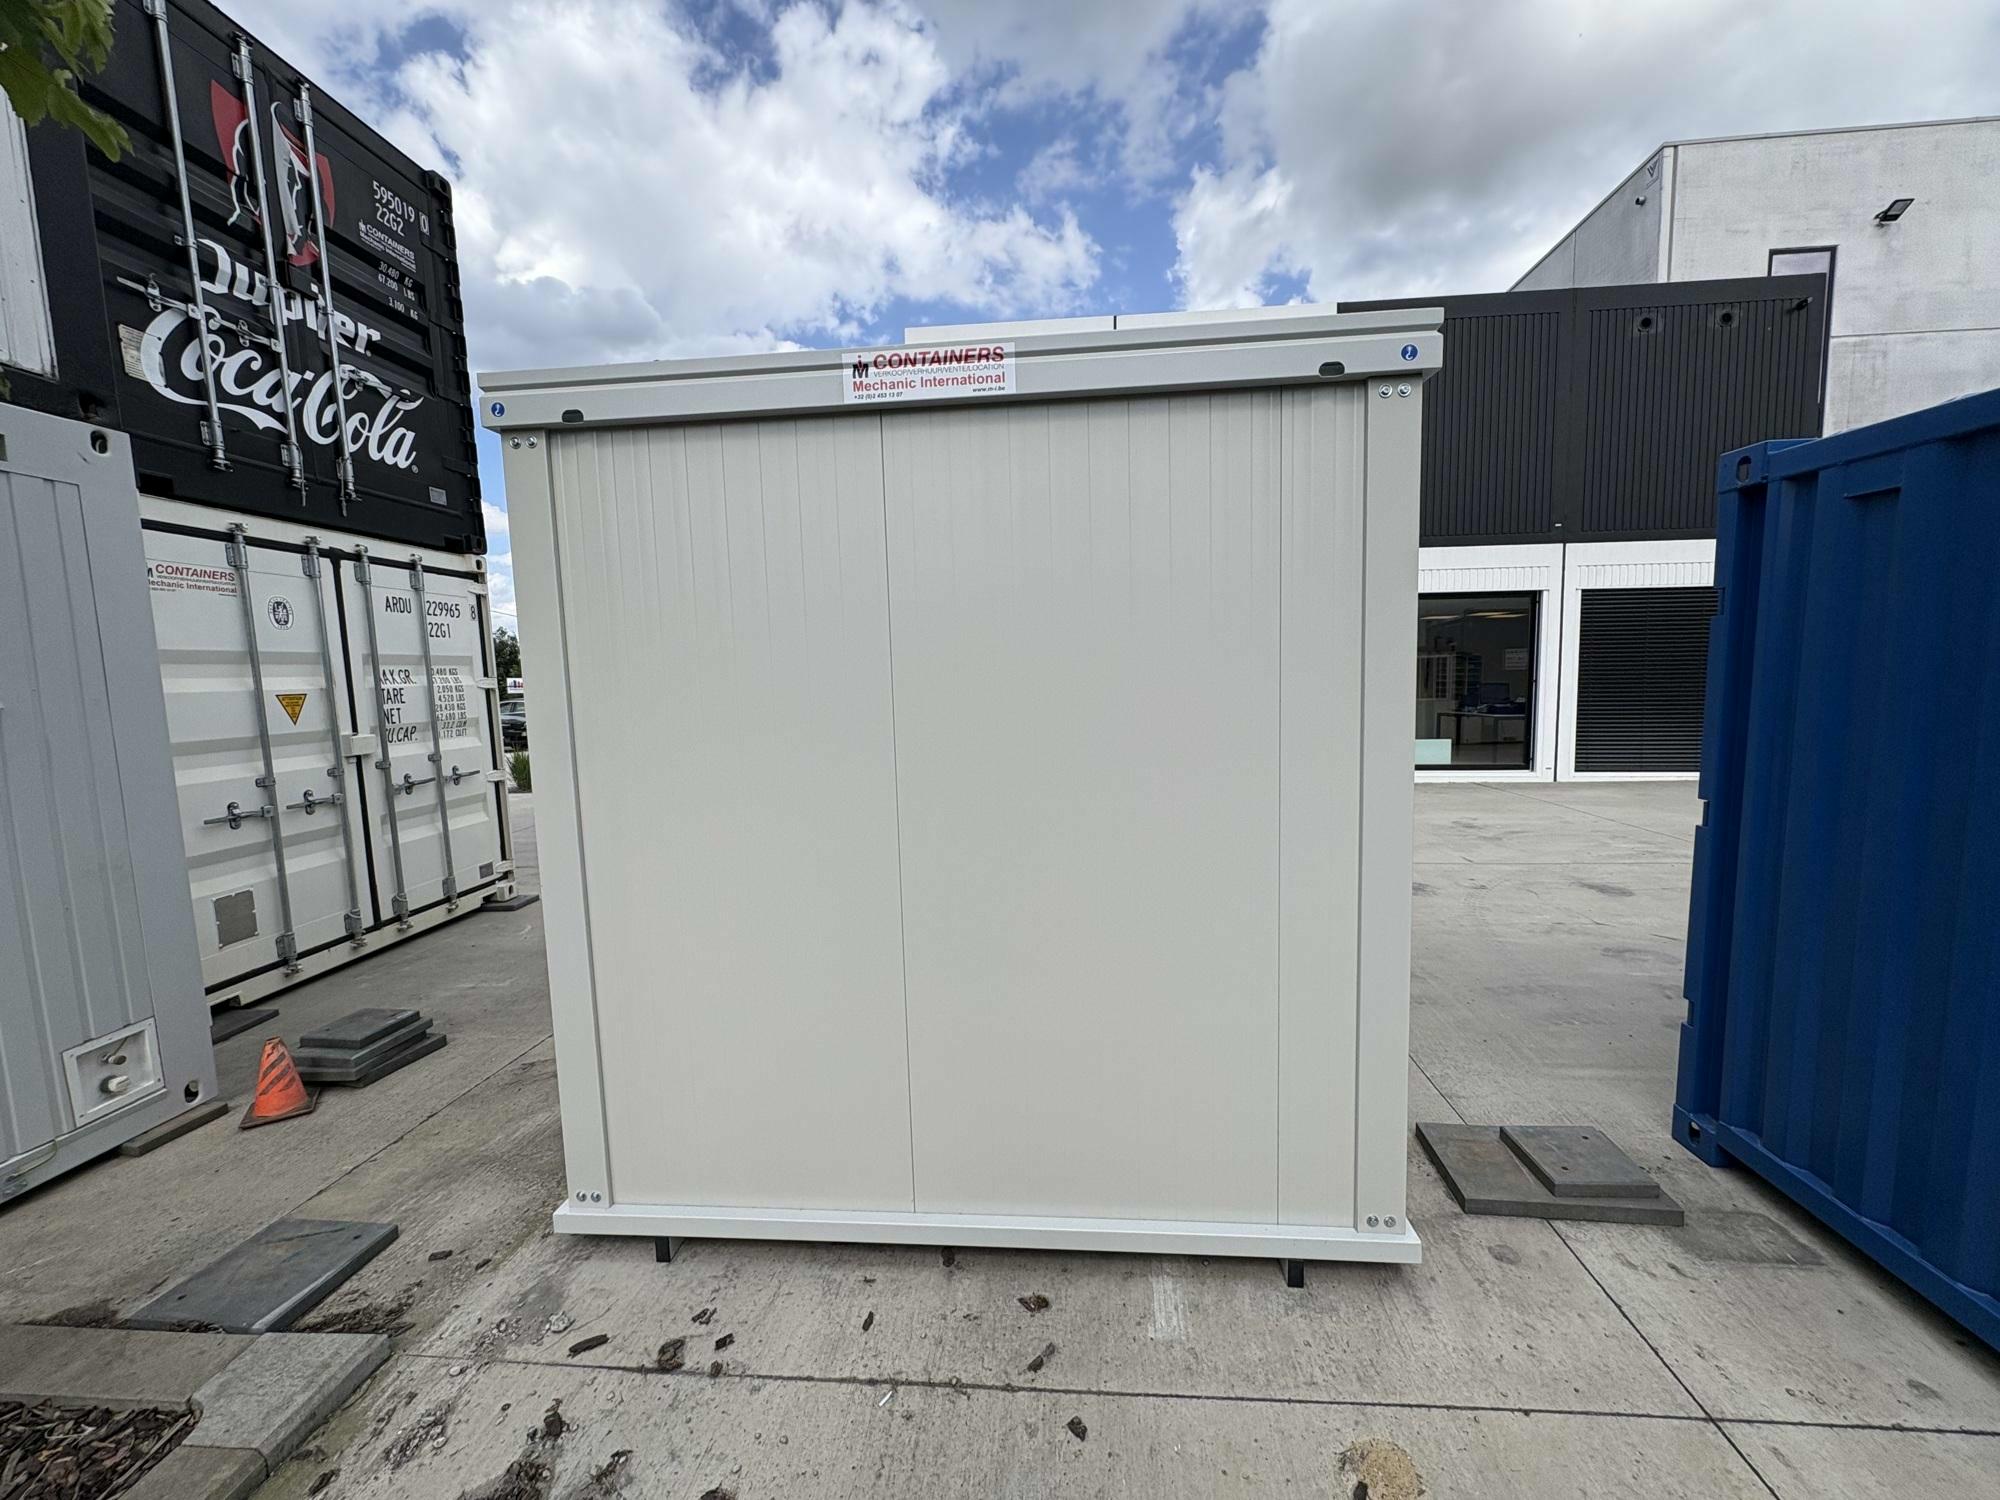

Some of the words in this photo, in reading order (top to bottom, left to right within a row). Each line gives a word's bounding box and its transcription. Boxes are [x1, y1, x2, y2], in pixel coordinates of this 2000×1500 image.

[373, 181, 415, 222] 595019
[376, 203, 404, 236] 22G2
[366, 224, 415, 260] CONTAINERS
[403, 287, 415, 301] LBS
[873, 346, 1005, 370] CONTAINERS
[873, 364, 1005, 378] VERKOOP/VERHUUR/VENTE/LOCATION
[852, 377, 917, 392] Mechanic
[920, 371, 1005, 388] International
[155, 564, 236, 582] CONTAINERS
[187, 582, 237, 593] International
[385, 596, 412, 614] ARDU
[426, 600, 461, 619] 229965
[470, 605, 477, 620] 8
[428, 622, 451, 638] 22G1
[380, 669, 417, 685] AX.GR.
[448, 667, 459, 676] KGS
[450, 676, 463, 684] LBS
[380, 688, 406, 704] TARE
[454, 685, 465, 693] KGS
[456, 693, 466, 702] LBS
[456, 702, 467, 711] KGS
[383, 708, 401, 725] NET
[457, 711, 467, 720] LBS
[386, 726, 418, 744] U.CAP.
